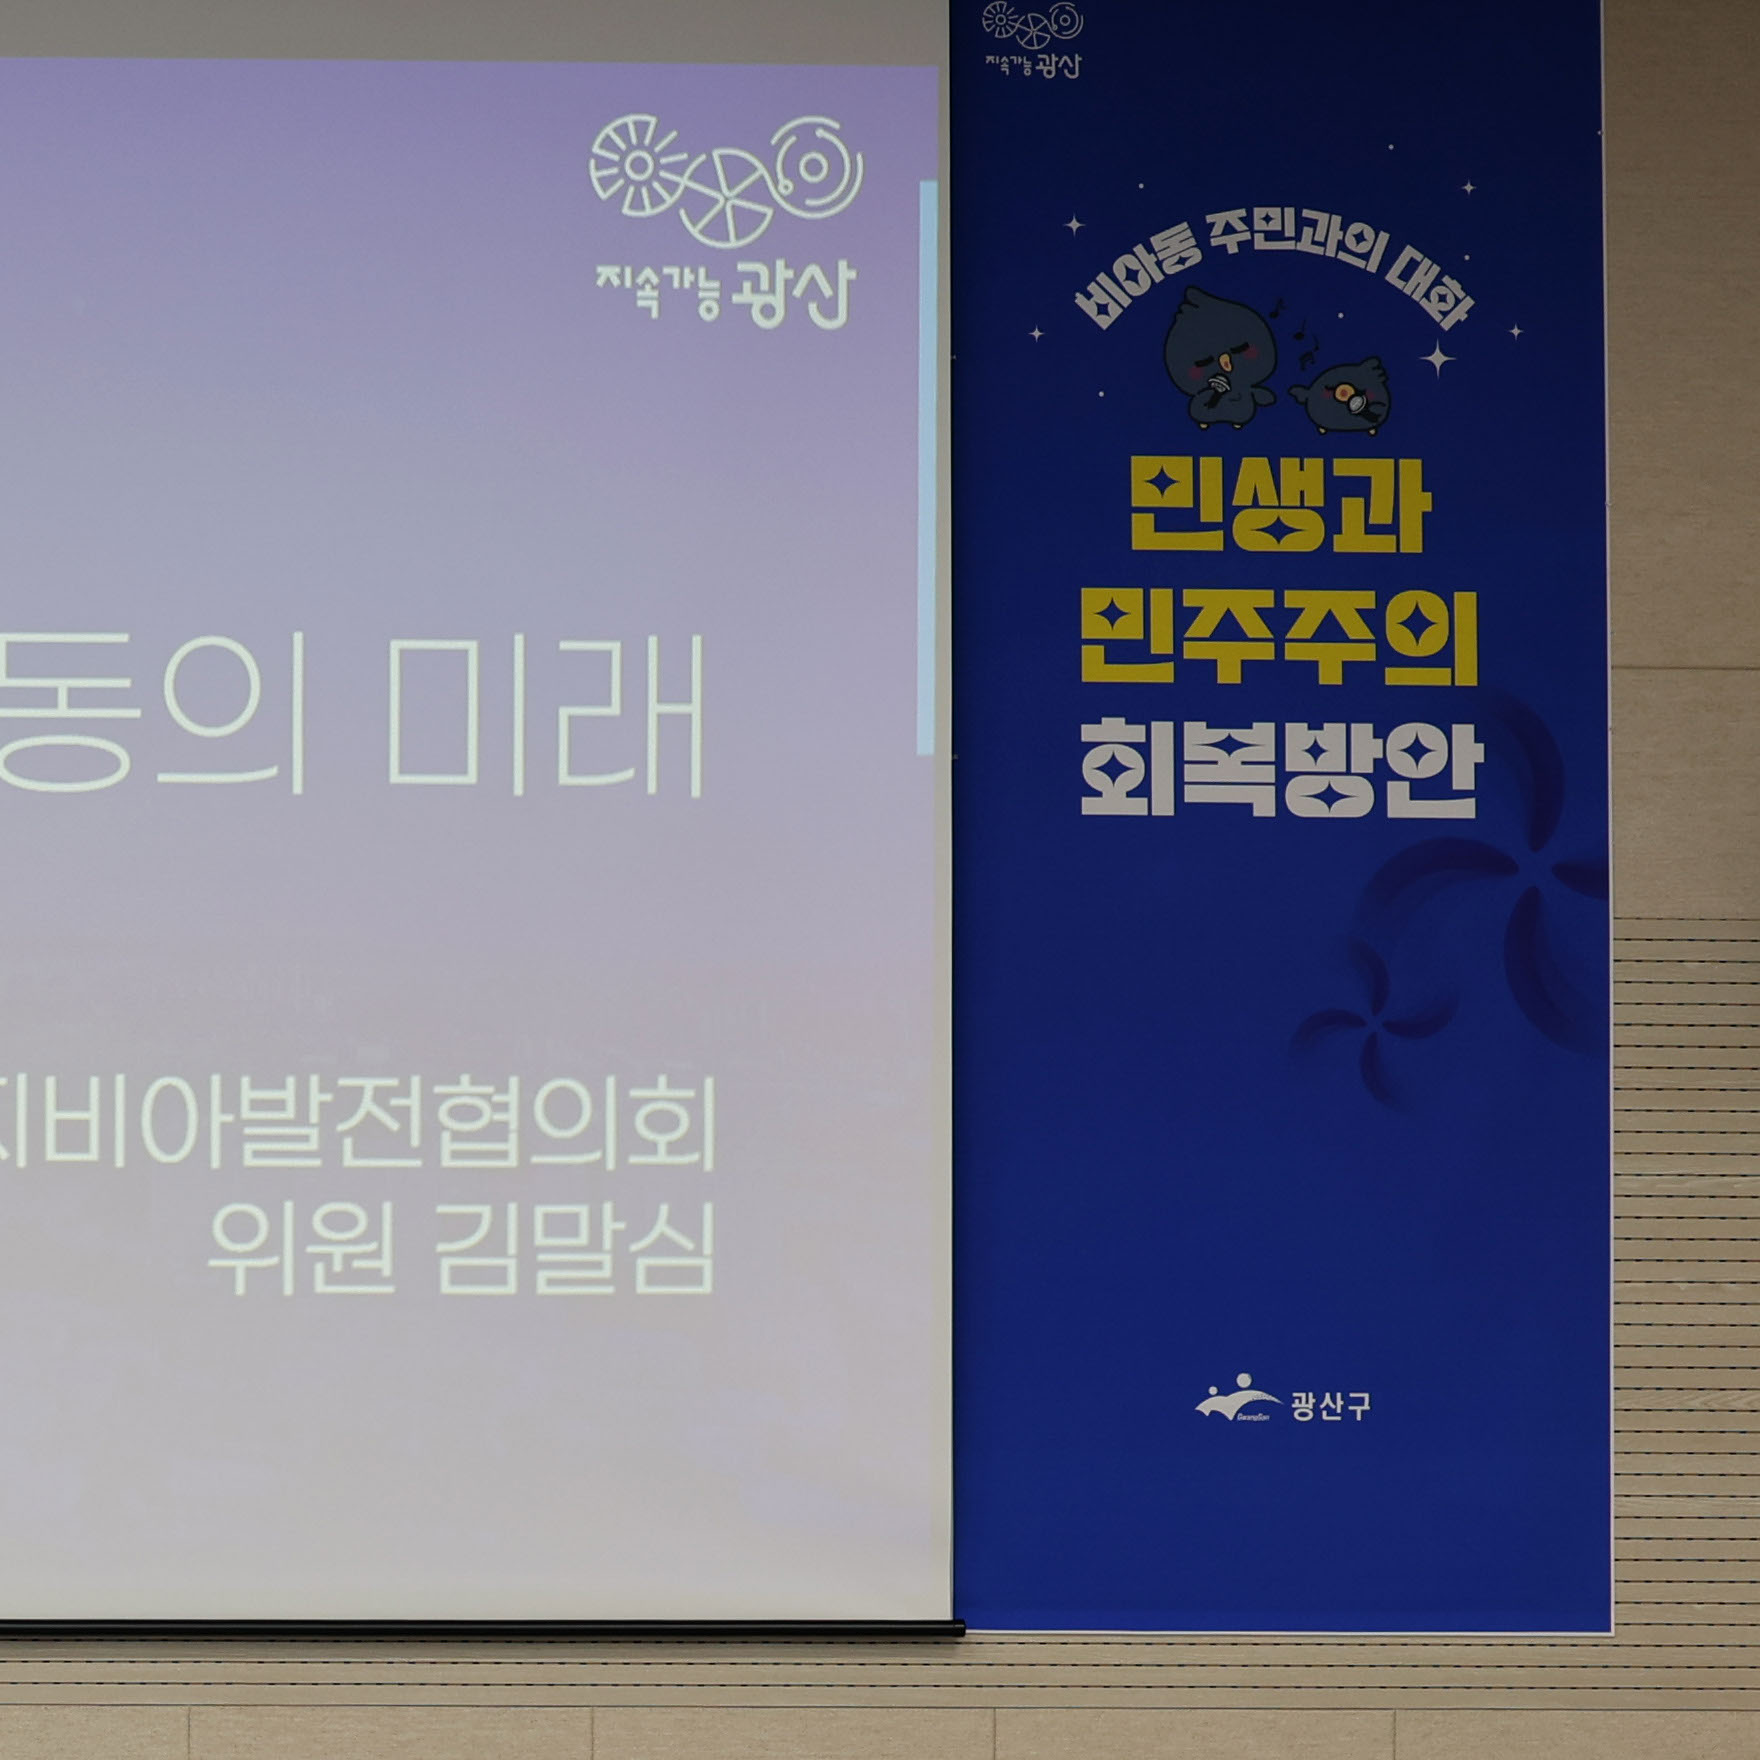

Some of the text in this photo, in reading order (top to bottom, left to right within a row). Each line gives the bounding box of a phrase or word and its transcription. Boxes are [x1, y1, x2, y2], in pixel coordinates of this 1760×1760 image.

[985, 54, 1082, 79] 지속가능 광산
[596, 258, 857, 330] 지속가능 광산
[1074, 207, 1476, 332] 비아동 주민과의 대화
[1130, 455, 1433, 553] 민생과
[1080, 587, 1478, 687] 민주주의
[389, 632, 703, 798] 미래
[1080, 716, 1485, 819] 회복방안
[207, 1200, 715, 1296] 위원 김말심
[1291, 1391, 1371, 1422] 광산구
